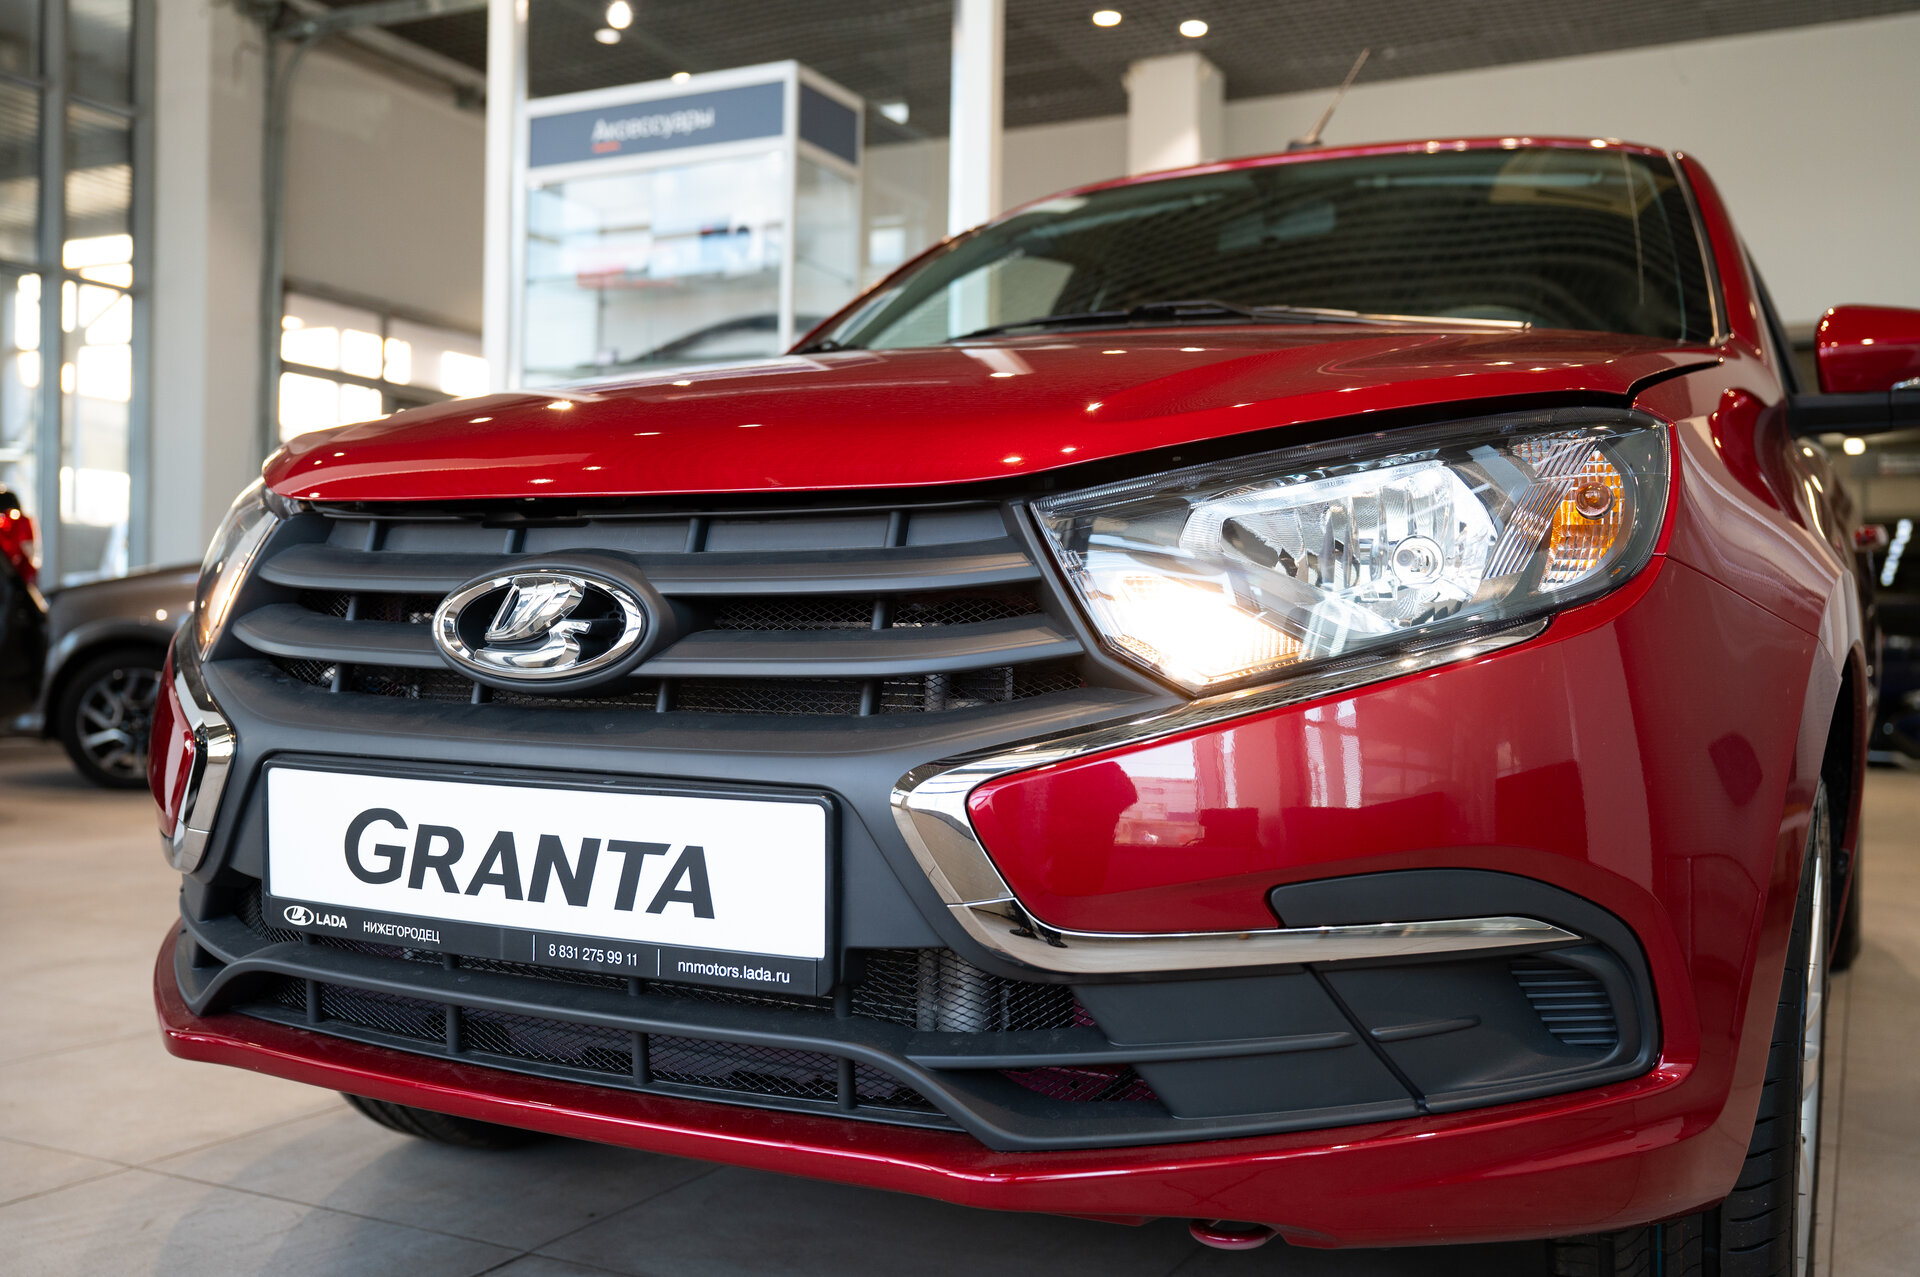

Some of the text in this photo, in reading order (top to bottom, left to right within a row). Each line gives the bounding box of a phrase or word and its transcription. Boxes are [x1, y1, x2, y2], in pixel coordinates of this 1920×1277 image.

[592, 107, 715, 142] Аксессуары
[344, 808, 716, 919] GRANTA
[316, 912, 348, 928] LADA
[363, 920, 441, 944] НИЖЕГОРОДЕЦ
[548, 943, 637, 967] 8 831 275 99 11
[677, 960, 790, 984] nnmotors.lada.ru
